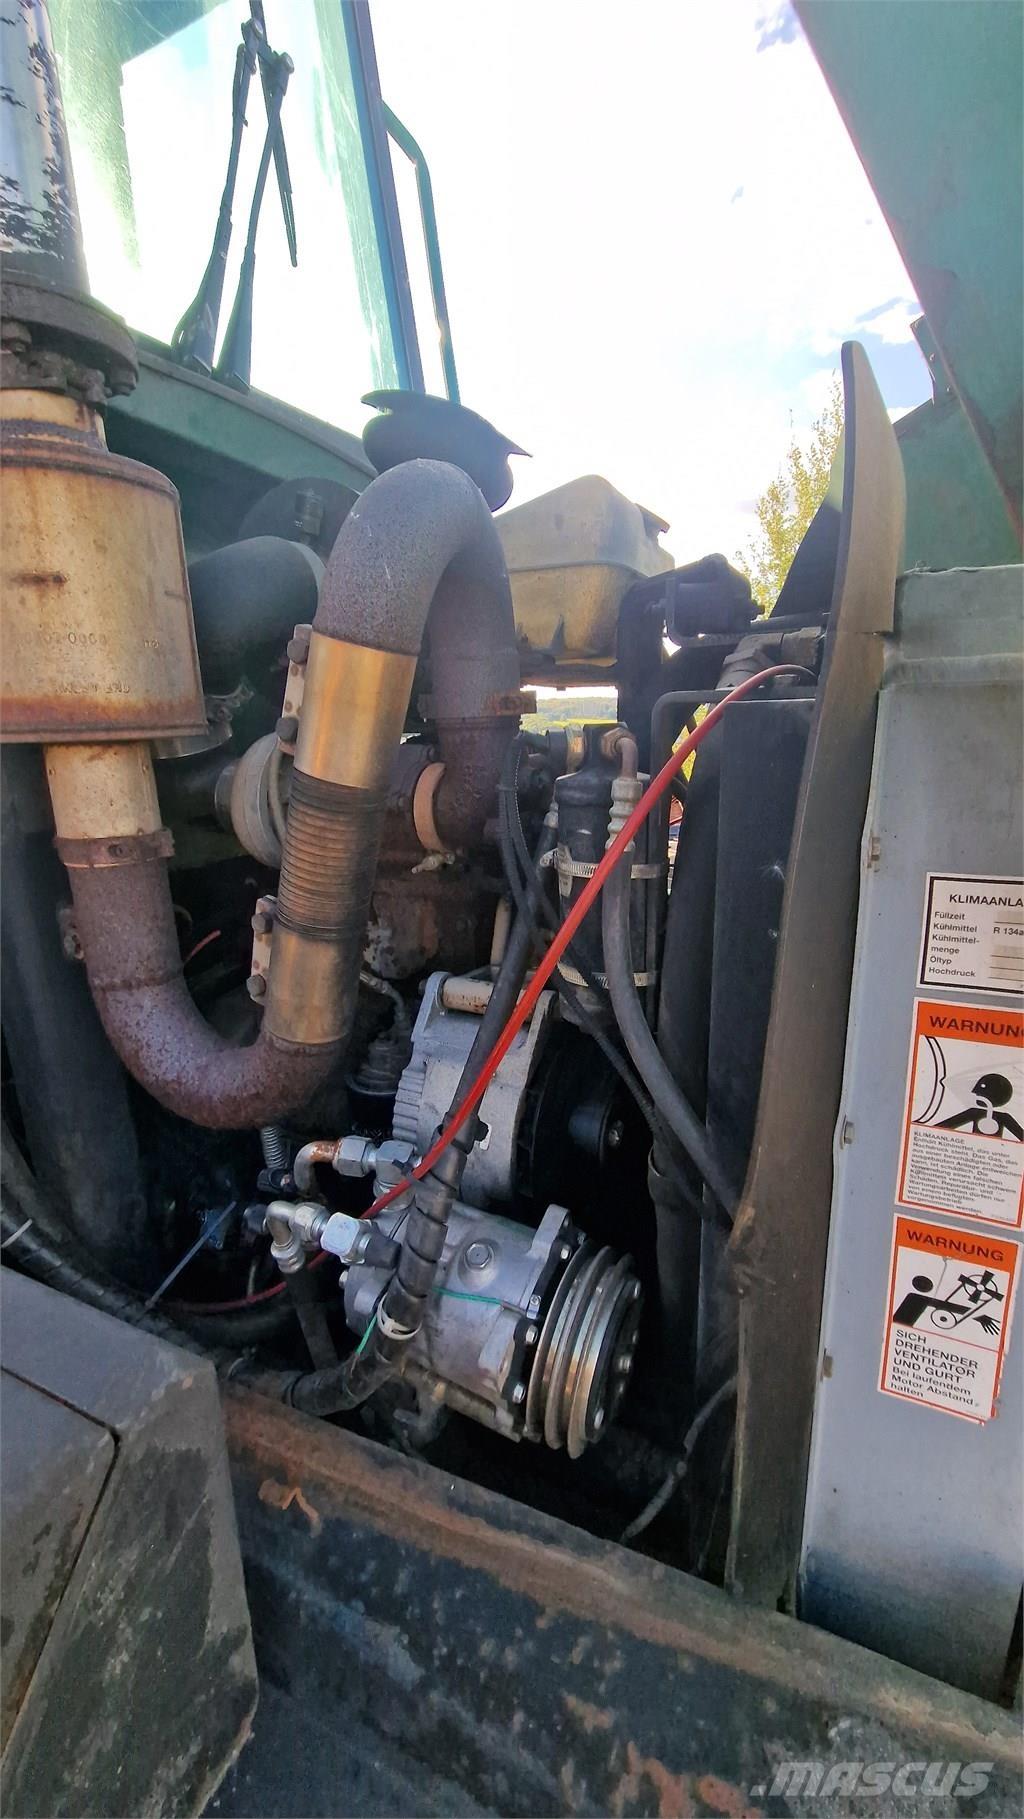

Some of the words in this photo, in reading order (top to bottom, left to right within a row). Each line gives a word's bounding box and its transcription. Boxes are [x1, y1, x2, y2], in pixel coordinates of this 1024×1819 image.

[934, 911, 966, 921] Füllzeit
[933, 922, 978, 933] Kühlmittel
[993, 926, 1001, 935] R
[932, 934, 980, 945] Kühlmittel-
[931, 946, 960, 955] menge
[928, 967, 976, 977] Hochdruck
[914, 1131, 965, 1144] KLIMAANLAGE
[907, 1229, 1004, 1261] WARNUNG
[896, 1329, 927, 1344] SICH
[895, 1339, 978, 1369] DREHENDER
[893, 1358, 921, 1371] UND
[925, 1367, 962, 1383] GURT
[894, 1348, 976, 1378] VENTILATOR
[893, 1366, 910, 1376] Bei
[912, 1372, 972, 1395] laufendem
[890, 1382, 924, 1398] halten
[891, 1374, 923, 1388] Motor
[927, 1385, 974, 1405] Abstand
